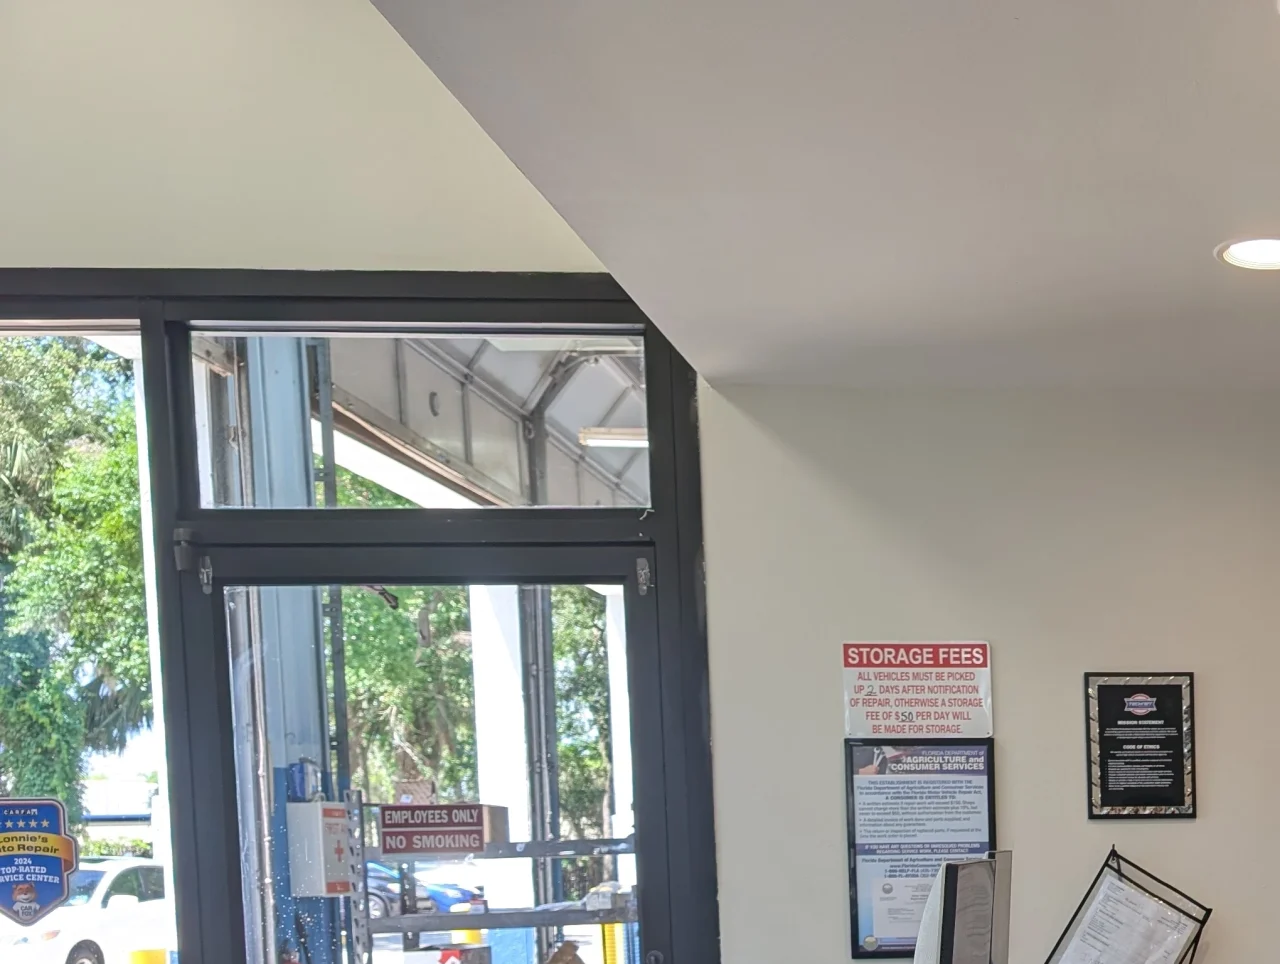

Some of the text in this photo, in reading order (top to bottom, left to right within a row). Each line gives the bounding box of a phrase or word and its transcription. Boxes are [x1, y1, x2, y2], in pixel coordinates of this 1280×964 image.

[848, 648, 984, 665] STORAGE FEES
[857, 672, 975, 681] ALL VEHICLES MUST BE PICKED
[854, 685, 864, 694] UP
[879, 685, 900, 694] DAYS
[902, 685, 926, 694] AFTER
[928, 685, 979, 694] NOTIFICATION
[850, 698, 983, 708] OF REPAIR, OTHERWISE A STORAGE
[866, 712, 880, 720] FEE
[882, 712, 892, 720] OF
[916, 712, 932, 720] PER
[934, 712, 950, 720] DAY
[952, 712, 971, 720] WILL
[872, 725, 962, 734] BE MADE FOR STORAGE.
[385, 809, 479, 824] EMPLOYEES ONLY
[0, 834, 48, 843] onnie's
[386, 834, 480, 848] NO SMOKING
[18, 844, 59, 854] Repair
[0, 866, 46, 874] TOP-RATED
[26, 874, 59, 883] CENTER
